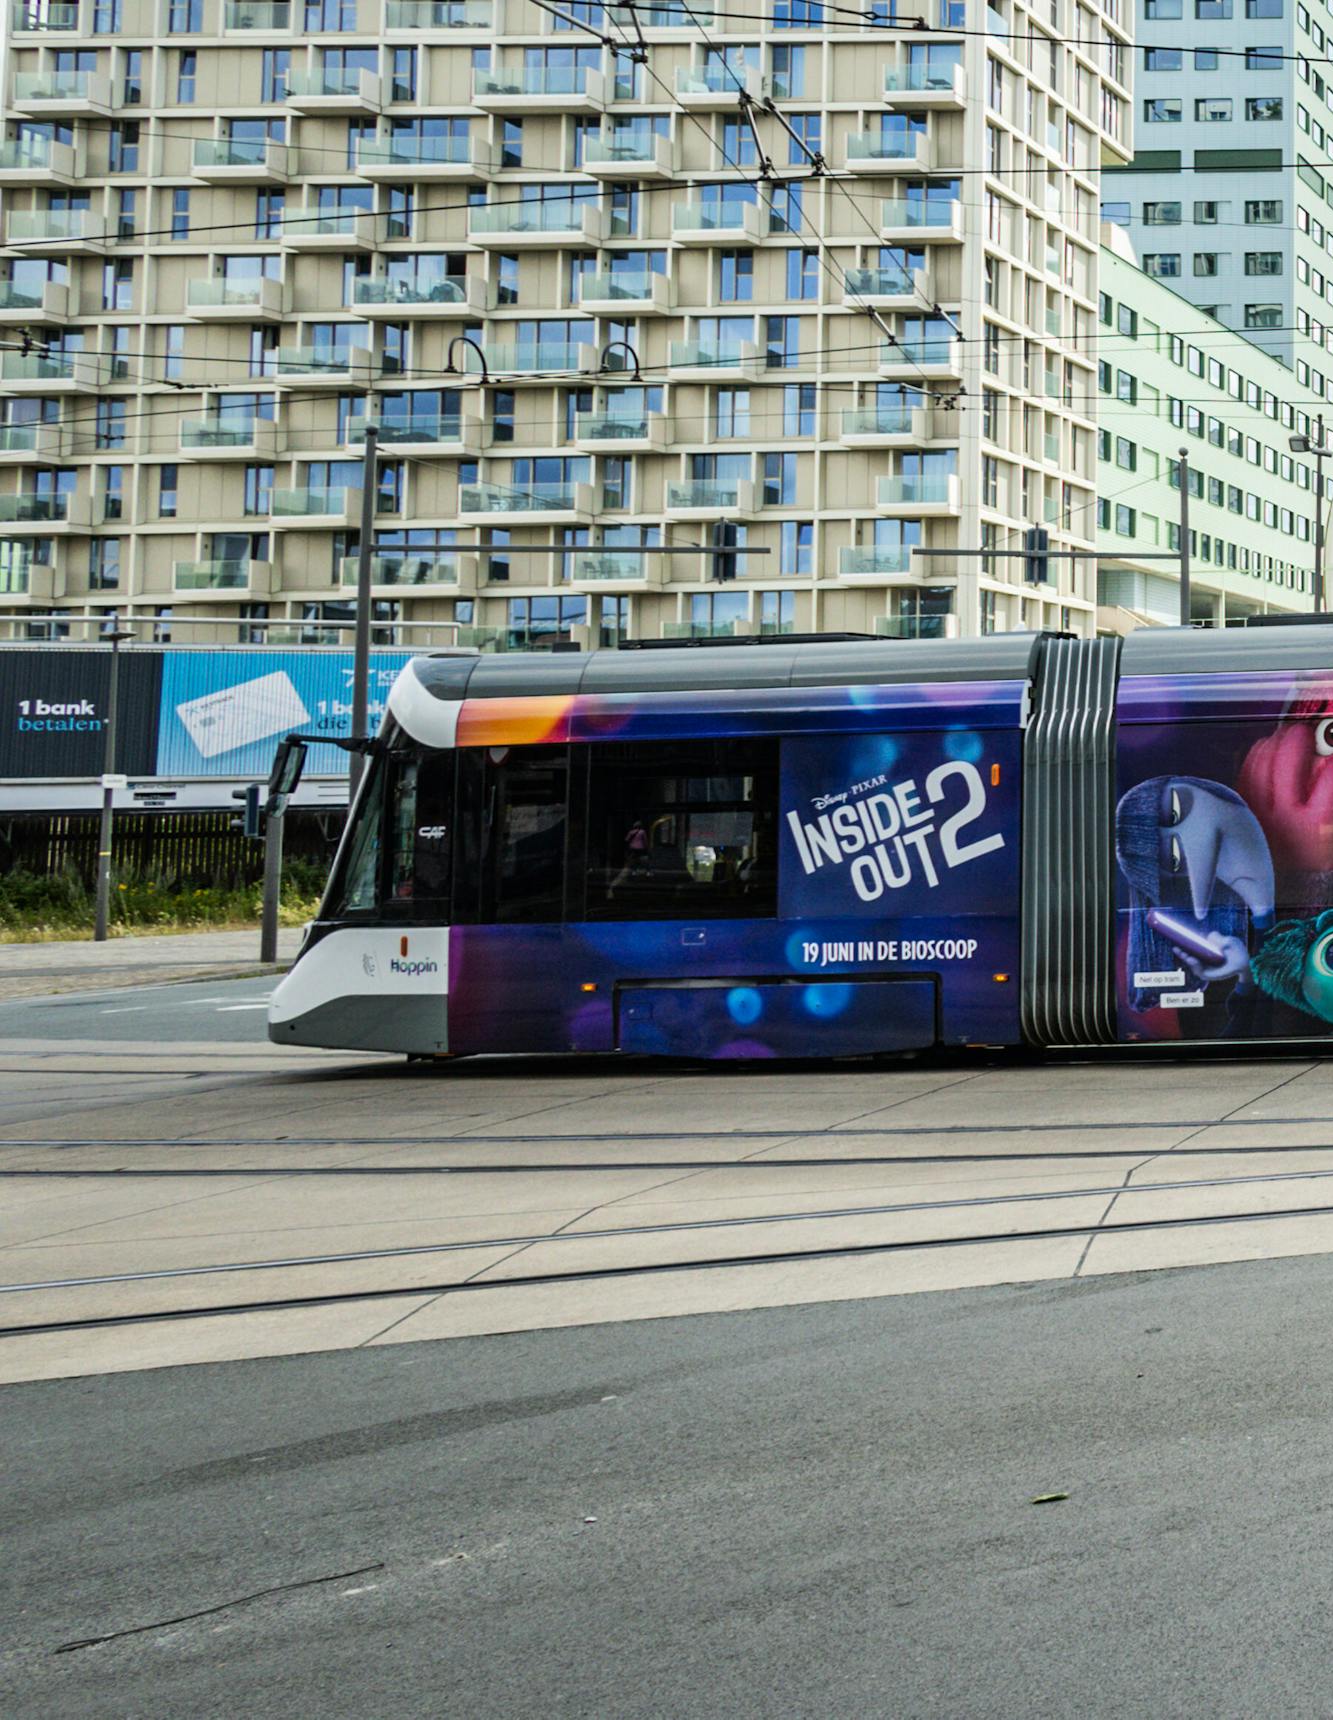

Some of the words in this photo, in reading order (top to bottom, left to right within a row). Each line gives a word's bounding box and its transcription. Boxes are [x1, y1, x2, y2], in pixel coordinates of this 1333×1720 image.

[18, 700, 30, 716] 1
[35, 699, 95, 716] bank
[317, 700, 327, 715] 1
[318, 717, 347, 730] die
[851, 774, 888, 795] PIXAR
[786, 779, 935, 876] INSIDE
[850, 824, 939, 902] OUT
[925, 760, 1006, 869] 2
[803, 943, 819, 963] 19
[820, 942, 854, 966] JUNI
[858, 942, 873, 961] IN
[877, 941, 898, 960] DE
[901, 939, 978, 960] BIOSCOOP
[390, 957, 438, 976] Hoppin
